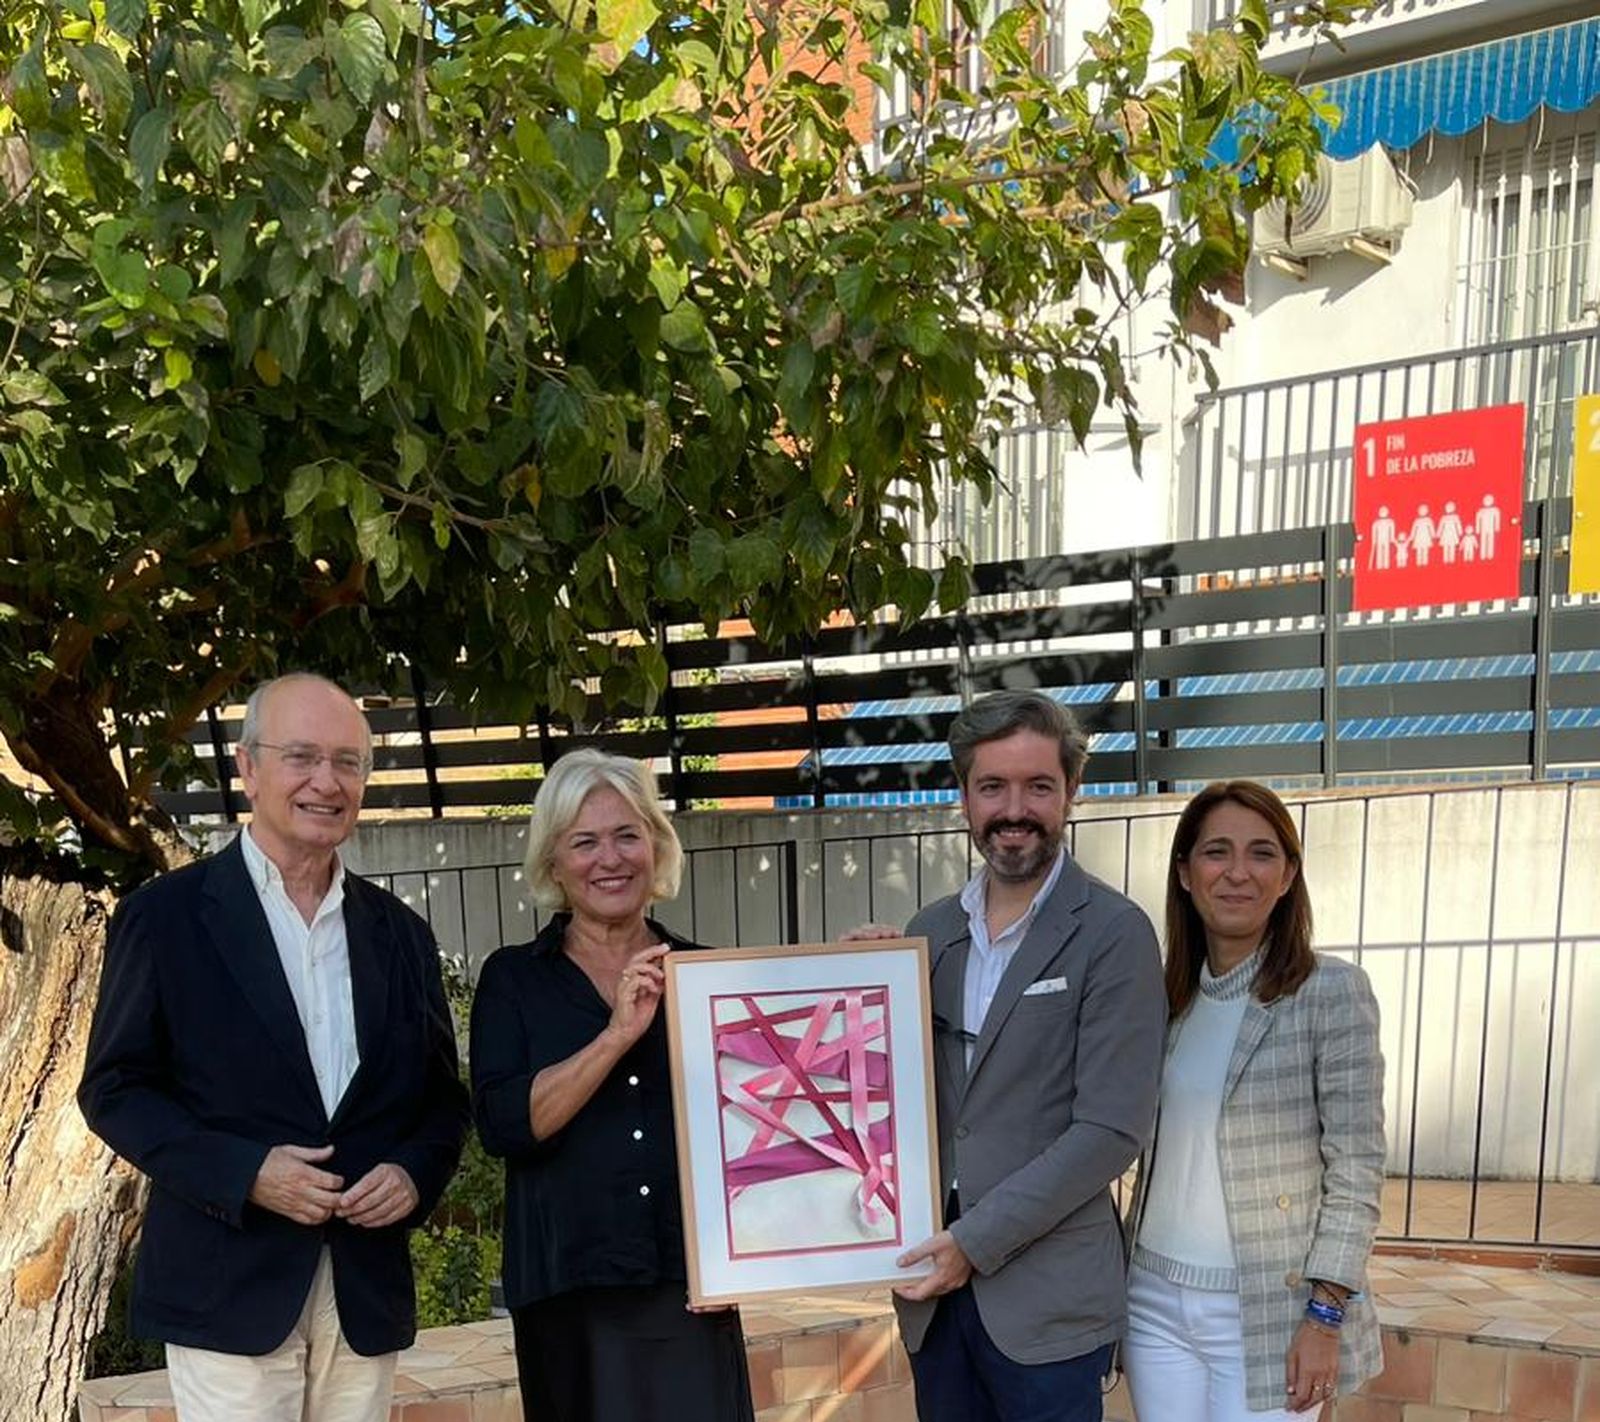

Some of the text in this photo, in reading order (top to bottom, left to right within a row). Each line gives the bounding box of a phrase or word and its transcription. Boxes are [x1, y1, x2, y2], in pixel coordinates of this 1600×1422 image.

[1386, 434, 1405, 451] FIN
[1362, 437, 1375, 478] 1
[1386, 448, 1475, 475] DE LA POBREZA
